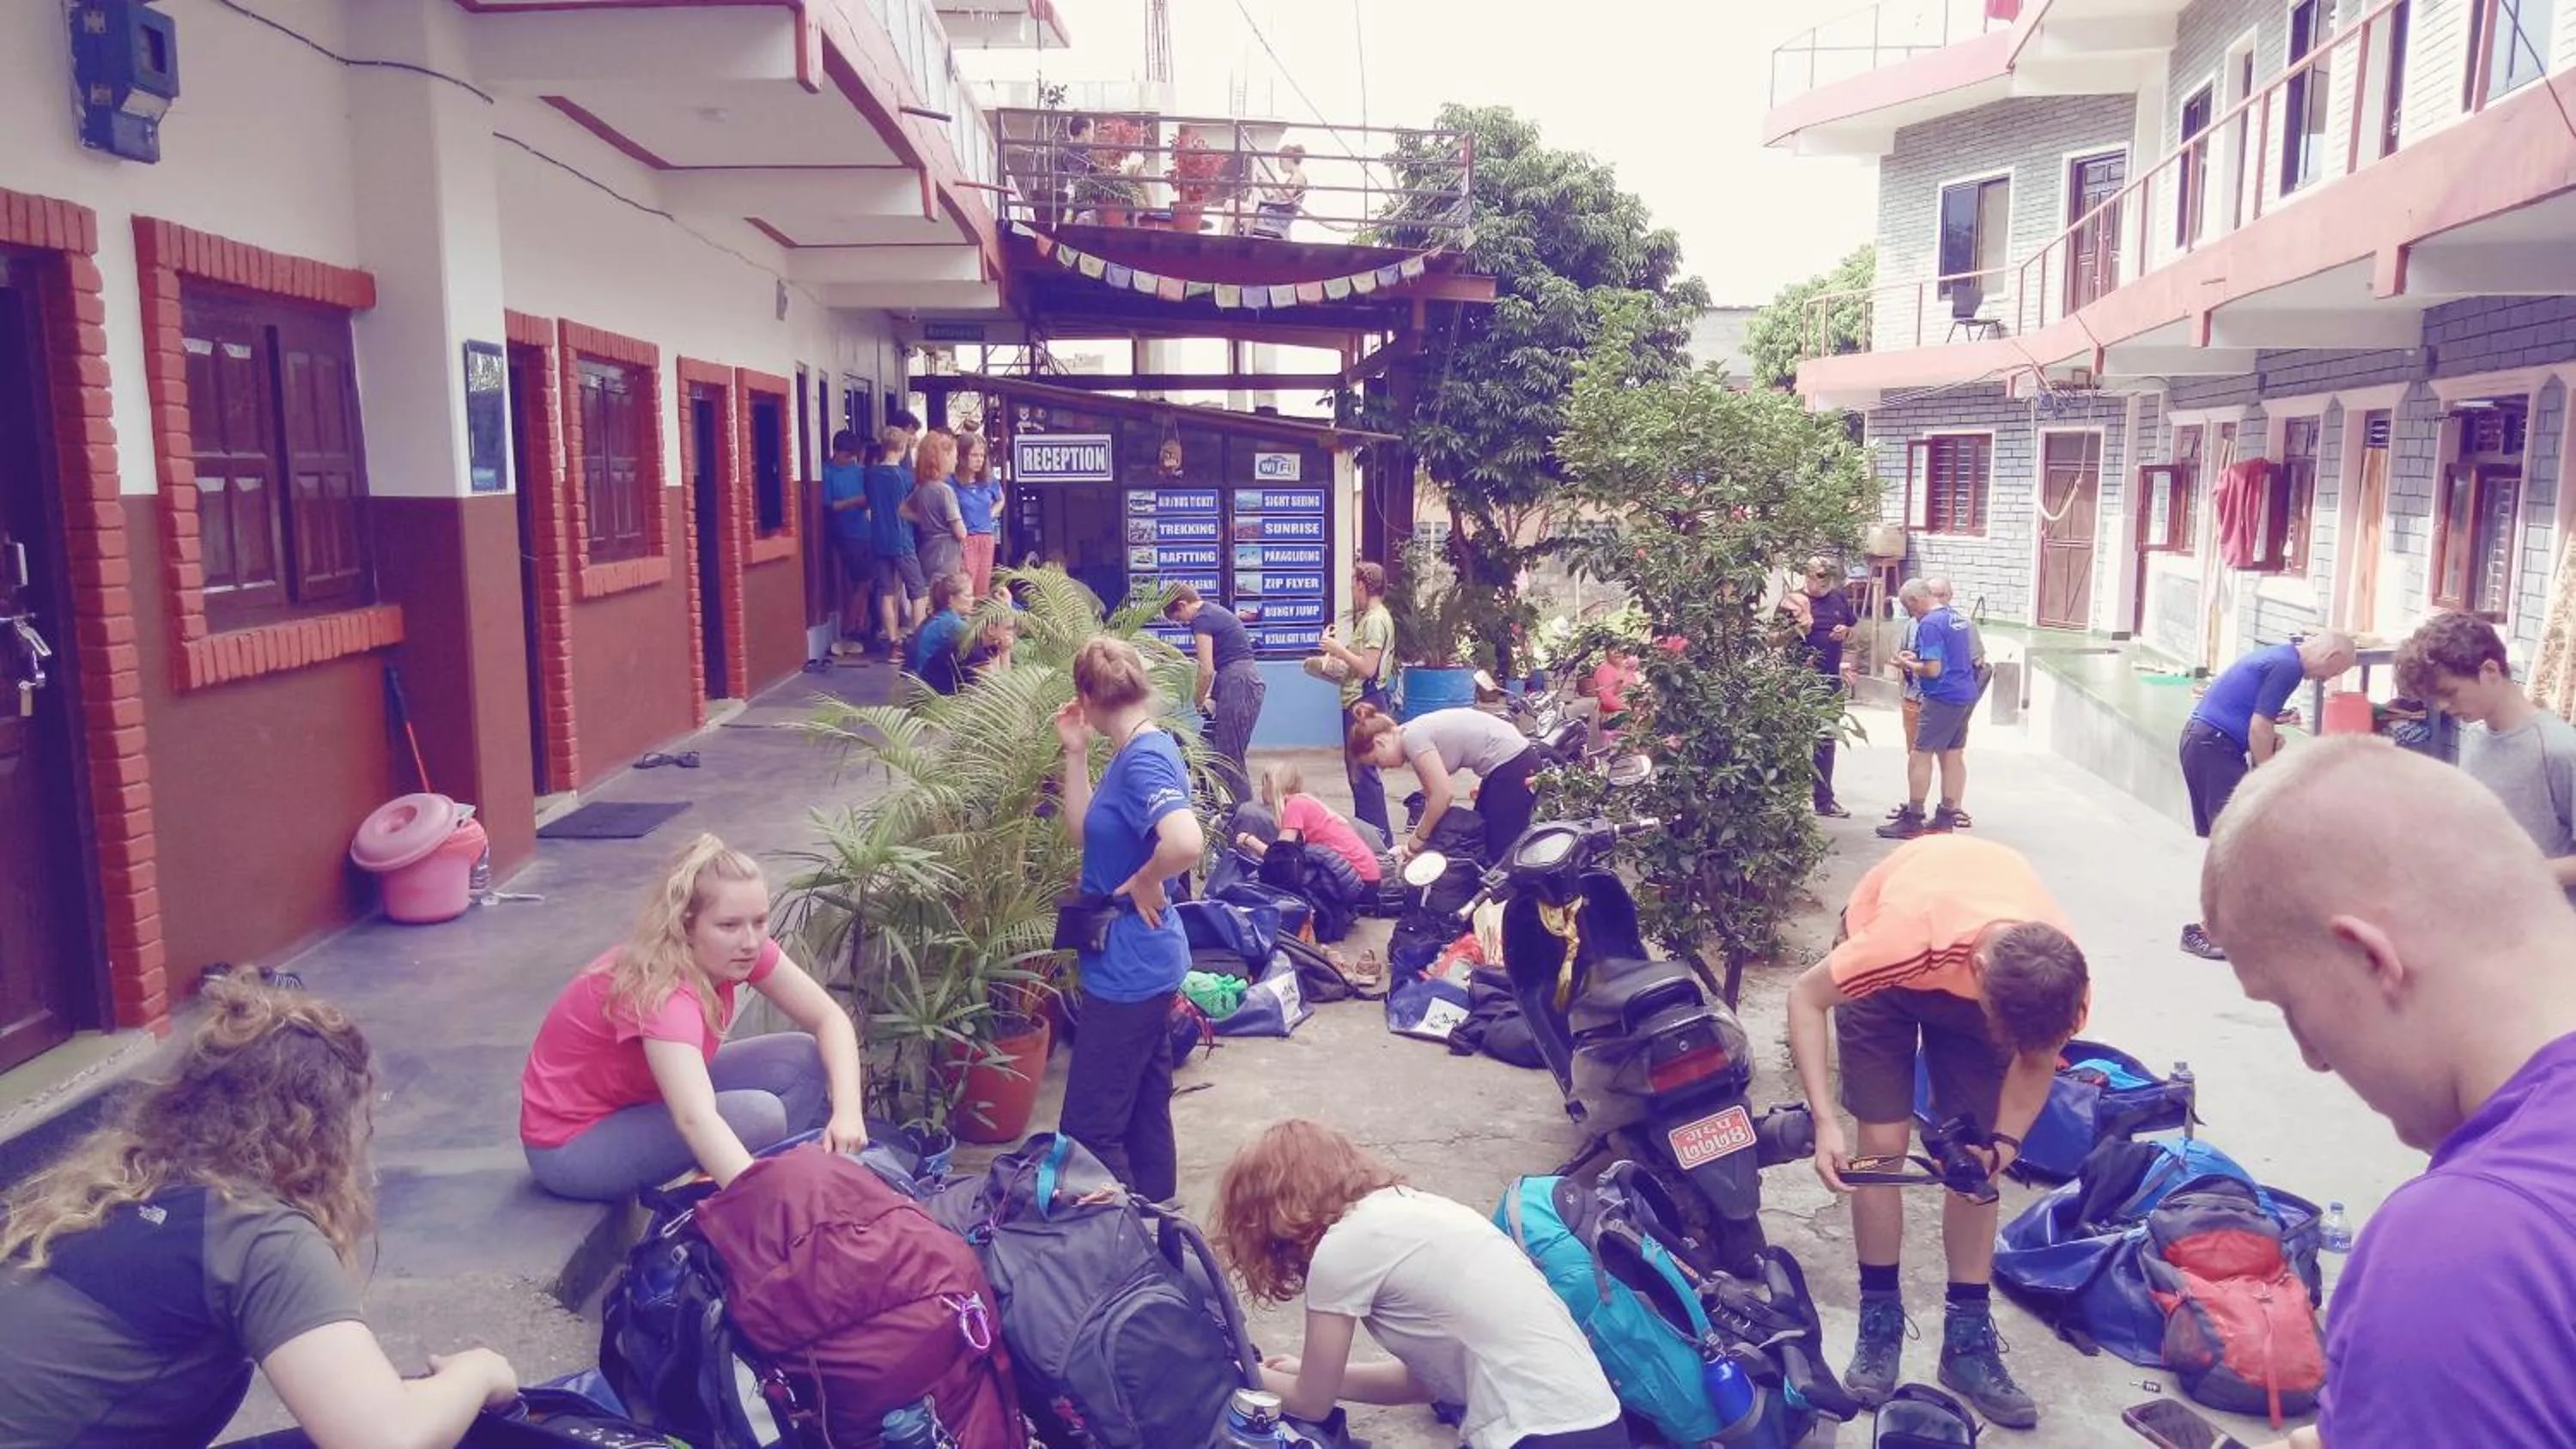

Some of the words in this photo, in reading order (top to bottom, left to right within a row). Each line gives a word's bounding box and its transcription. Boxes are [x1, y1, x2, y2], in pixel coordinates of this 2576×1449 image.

[1023, 446, 1106, 472] RECEPTION
[1265, 495, 1291, 507] SIGHT
[1159, 524, 1217, 536] TREKKING
[1265, 523, 1320, 535] SUNRISE
[1265, 550, 1320, 562] PARAGLIDING
[1264, 578, 1285, 590] ZIP
[1286, 578, 1320, 590] FLYER
[1295, 605, 1320, 616] JUMP
